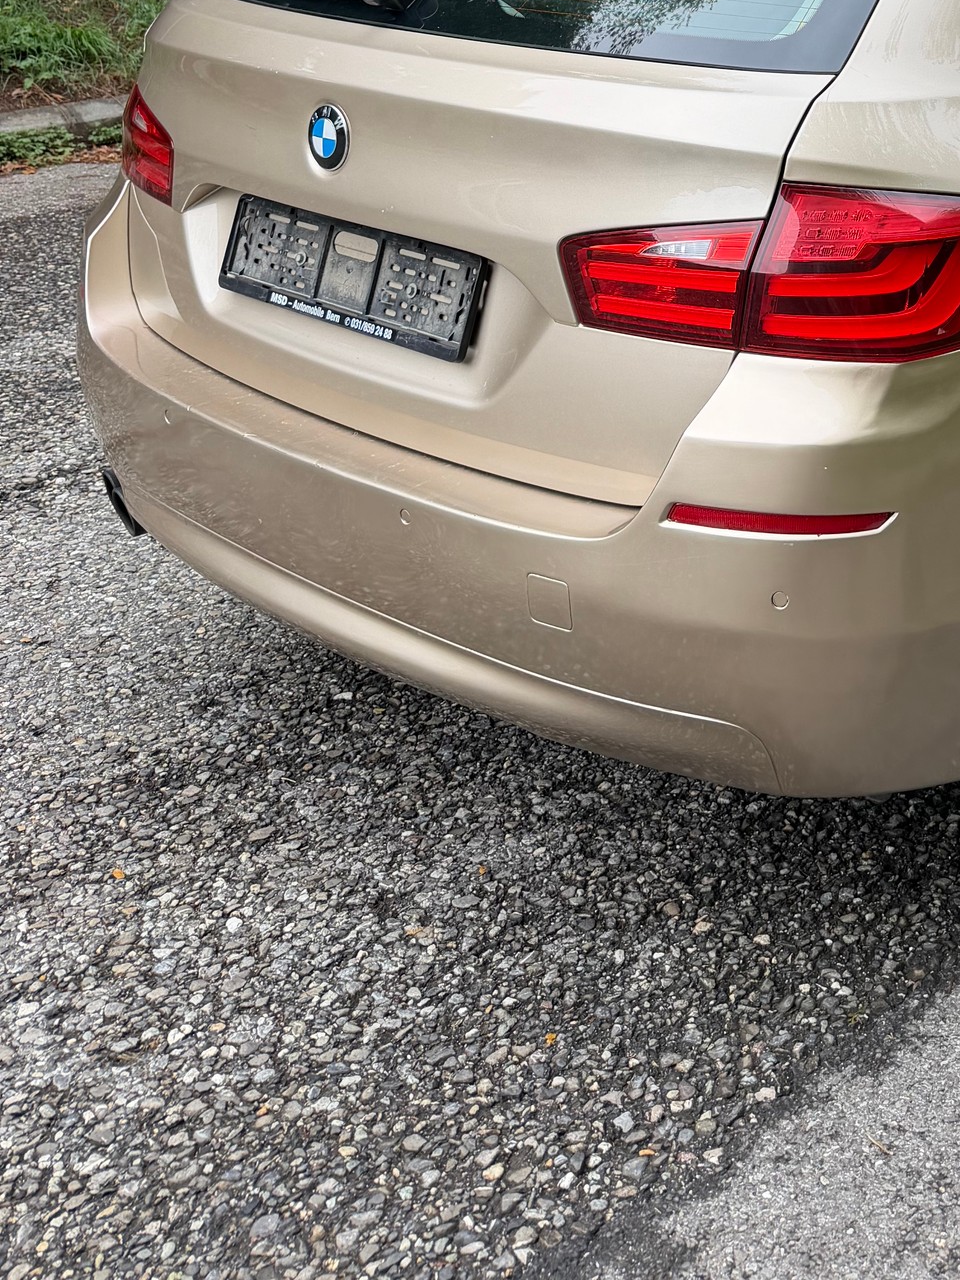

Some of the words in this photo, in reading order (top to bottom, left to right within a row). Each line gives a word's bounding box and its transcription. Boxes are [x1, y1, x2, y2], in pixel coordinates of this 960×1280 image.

[270, 291, 288, 306] MSD
[292, 299, 325, 318] Automobile
[325, 309, 341, 323] Bern
[374, 325, 384, 337] 24
